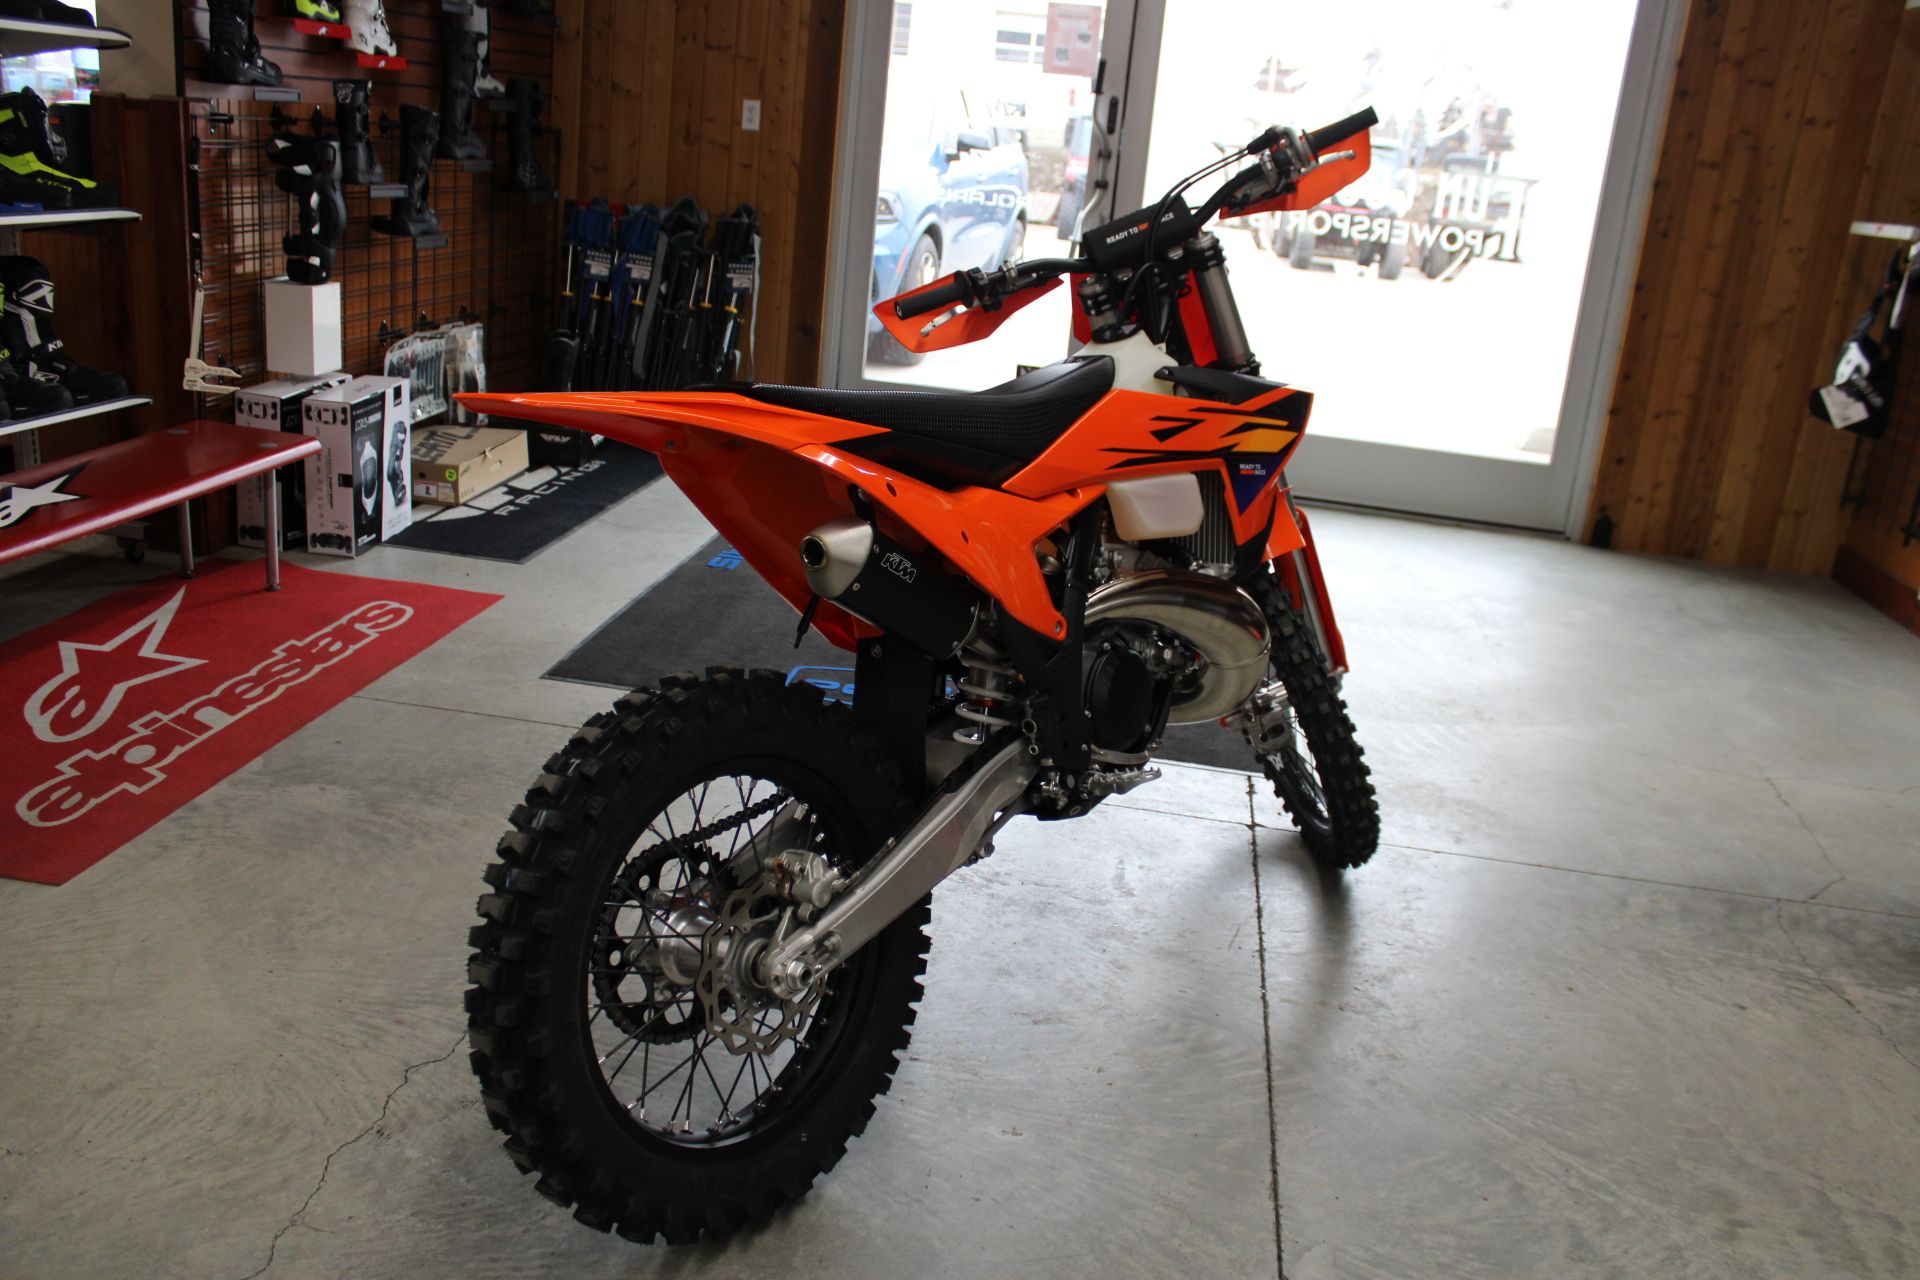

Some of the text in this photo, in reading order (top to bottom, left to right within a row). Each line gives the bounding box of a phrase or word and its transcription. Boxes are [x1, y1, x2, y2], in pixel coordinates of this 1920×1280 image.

[1106, 230, 1129, 244] READY
[1129, 227, 1139, 236] TO
[493, 460, 606, 516] RACING
[880, 552, 917, 583] KTM
[15, 600, 415, 828] alpinestars
